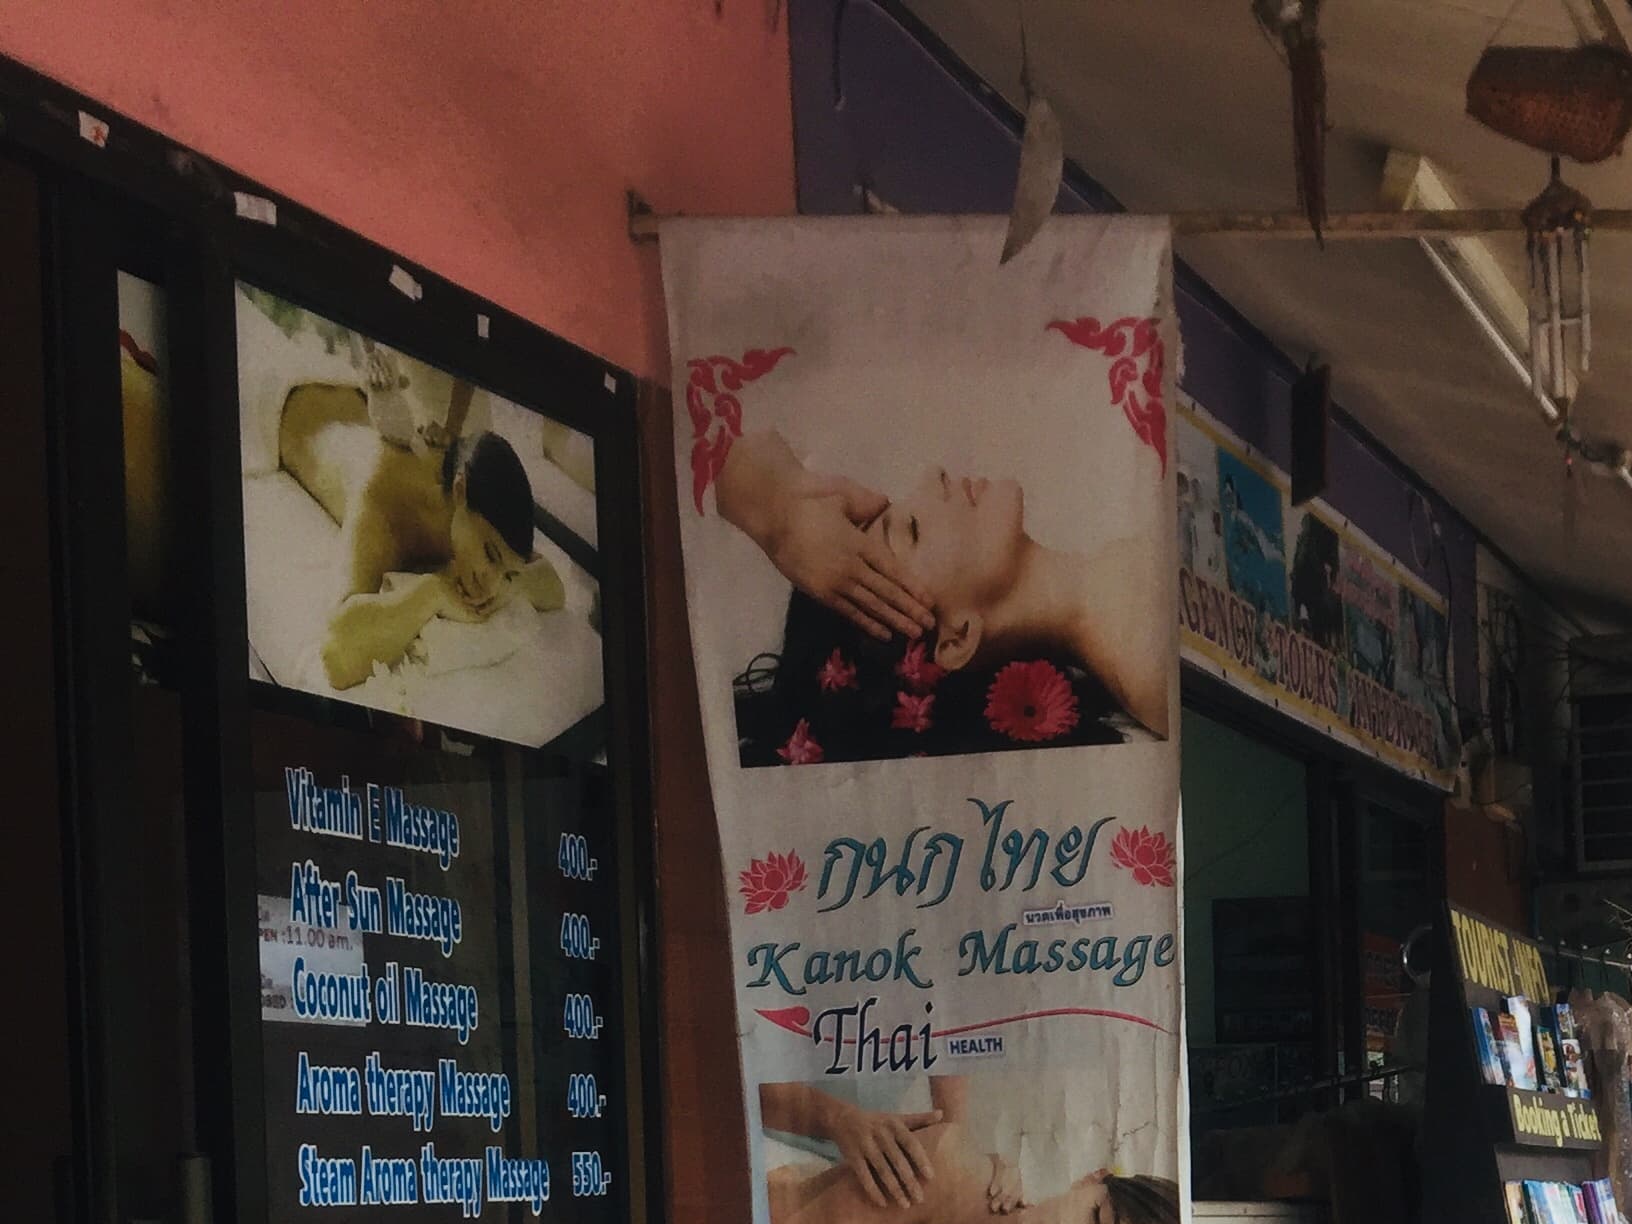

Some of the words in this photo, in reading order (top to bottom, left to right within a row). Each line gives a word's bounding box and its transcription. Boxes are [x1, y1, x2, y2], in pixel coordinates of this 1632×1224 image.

[1178, 569, 1257, 670] GENCY
[1275, 623, 1340, 714] TOURS
[286, 767, 363, 840] Vitamin
[367, 784, 381, 843] E
[384, 786, 459, 871] Massage
[291, 860, 341, 929] After
[345, 870, 382, 933] Sun
[387, 876, 462, 958] Massage
[745, 928, 934, 996] Kanok
[958, 922, 1175, 987] Massage
[1450, 909, 1516, 997] TOURIST
[293, 957, 371, 1024] Coconut
[376, 962, 400, 1025] oil
[404, 967, 478, 1045] Massage
[812, 996, 938, 1074] Thai
[949, 1037, 1003, 1055] HEALTH
[296, 1052, 361, 1114] Aroma
[365, 1051, 435, 1131] therapy
[439, 1059, 510, 1132] Massage
[1513, 1094, 1563, 1147] Booking
[1560, 1110, 1571, 1137] a
[1567, 1102, 1602, 1142] Ticket
[299, 1144, 356, 1206] Steam
[361, 1146, 418, 1205] Aroma
[421, 1142, 483, 1217] therapy
[486, 1146, 550, 1216] Massage
